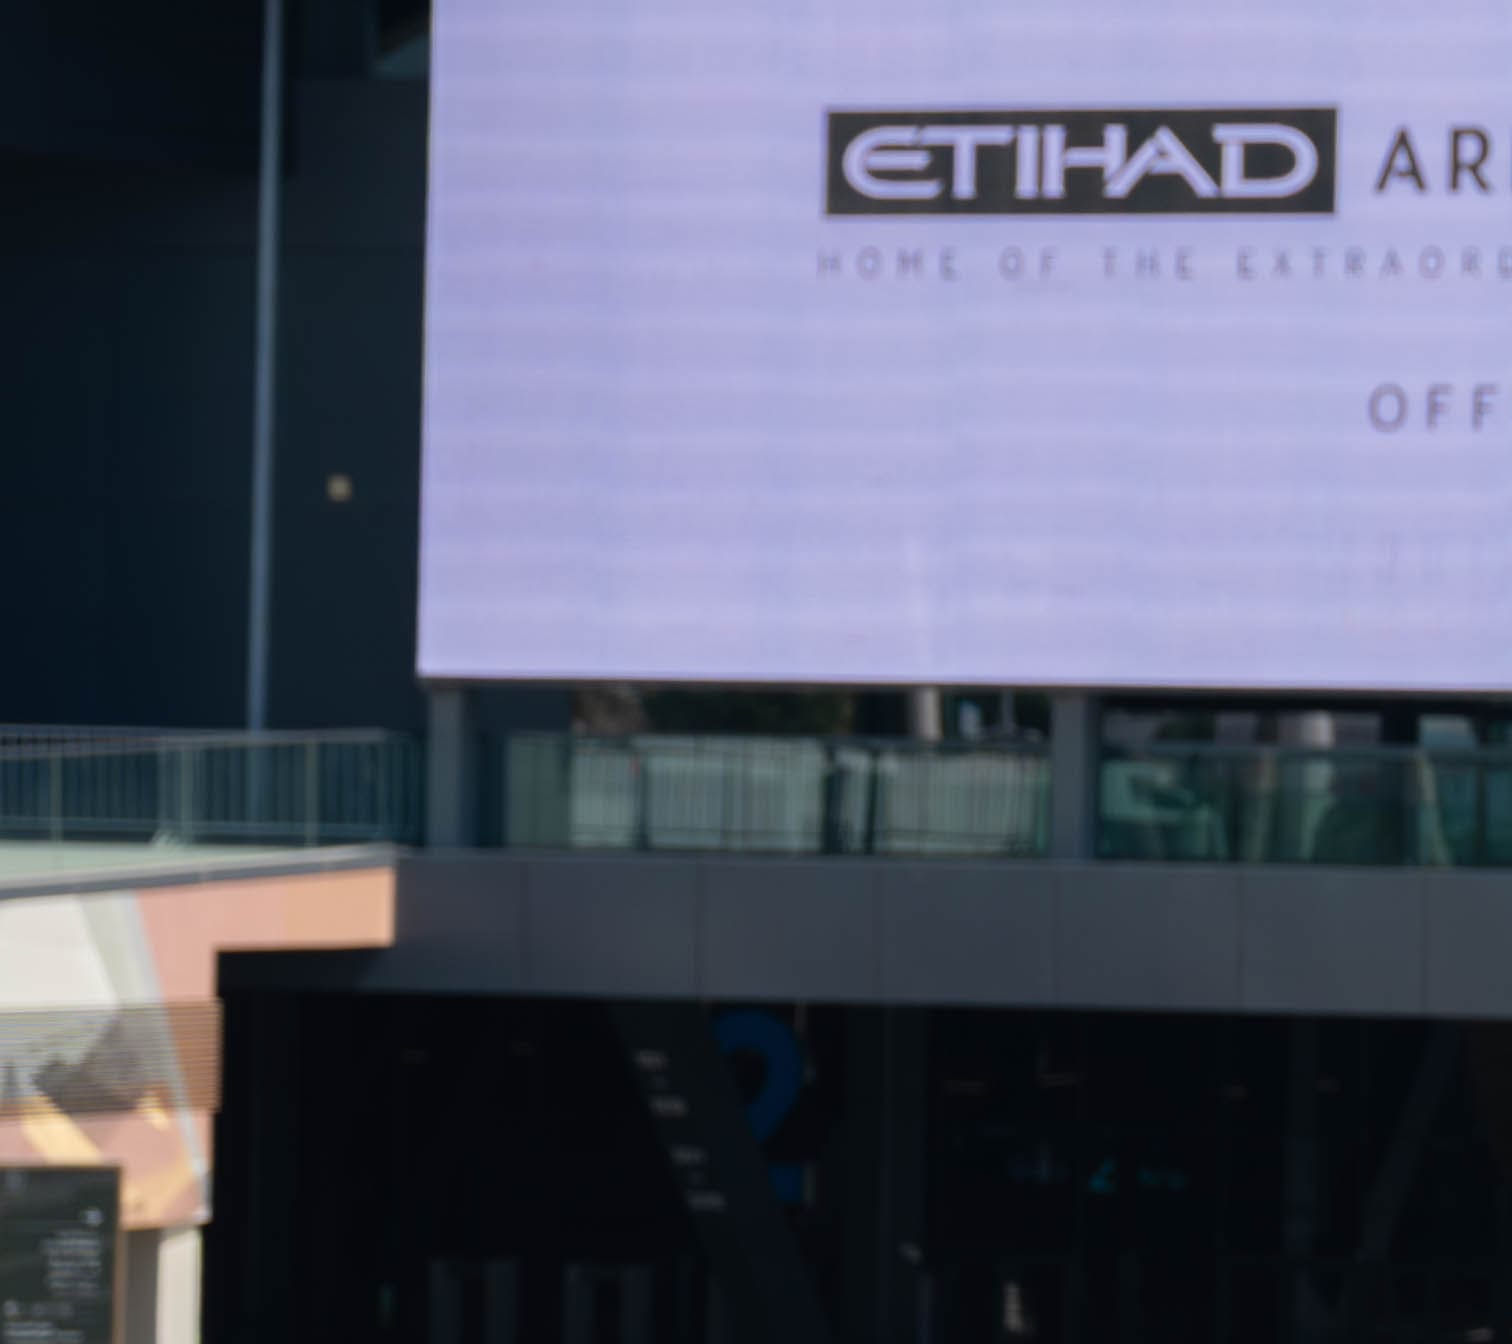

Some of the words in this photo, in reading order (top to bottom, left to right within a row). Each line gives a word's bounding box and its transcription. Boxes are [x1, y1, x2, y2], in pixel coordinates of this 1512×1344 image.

[841, 123, 1319, 201] ETIHAD
[816, 245, 958, 282] HOME
[1001, 245, 1057, 282] OF
[1102, 245, 1198, 282] THE
